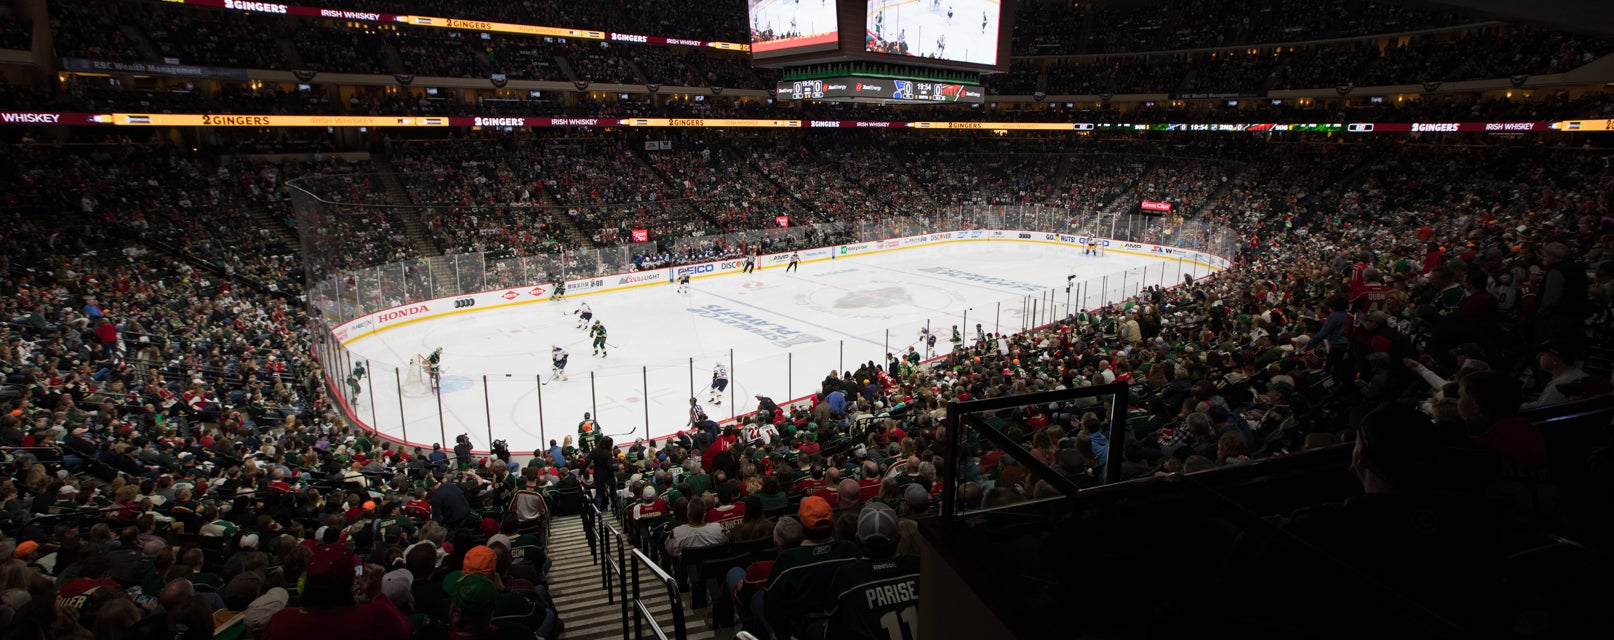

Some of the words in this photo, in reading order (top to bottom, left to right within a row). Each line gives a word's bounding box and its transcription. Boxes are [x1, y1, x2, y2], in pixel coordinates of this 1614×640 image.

[321, 9, 342, 18] IRISH
[343, 11, 380, 21] WHISKEY
[94, 61, 112, 70] RBC
[113, 62, 146, 73] Wealth
[147, 64, 201, 76] Management
[917, 83, 932, 91] 19:54
[1, 112, 60, 123] WHISKEY
[335, 117, 374, 125] WHISKEY
[1504, 122, 1535, 130] WHISKEY
[930, 232, 952, 242] DISCOVER
[722, 260, 745, 270] DISCOV
[644, 273, 660, 281] LIGHT
[378, 304, 429, 323] HONDA
[748, 426, 761, 440] 22
[865, 580, 919, 610] PARISE
